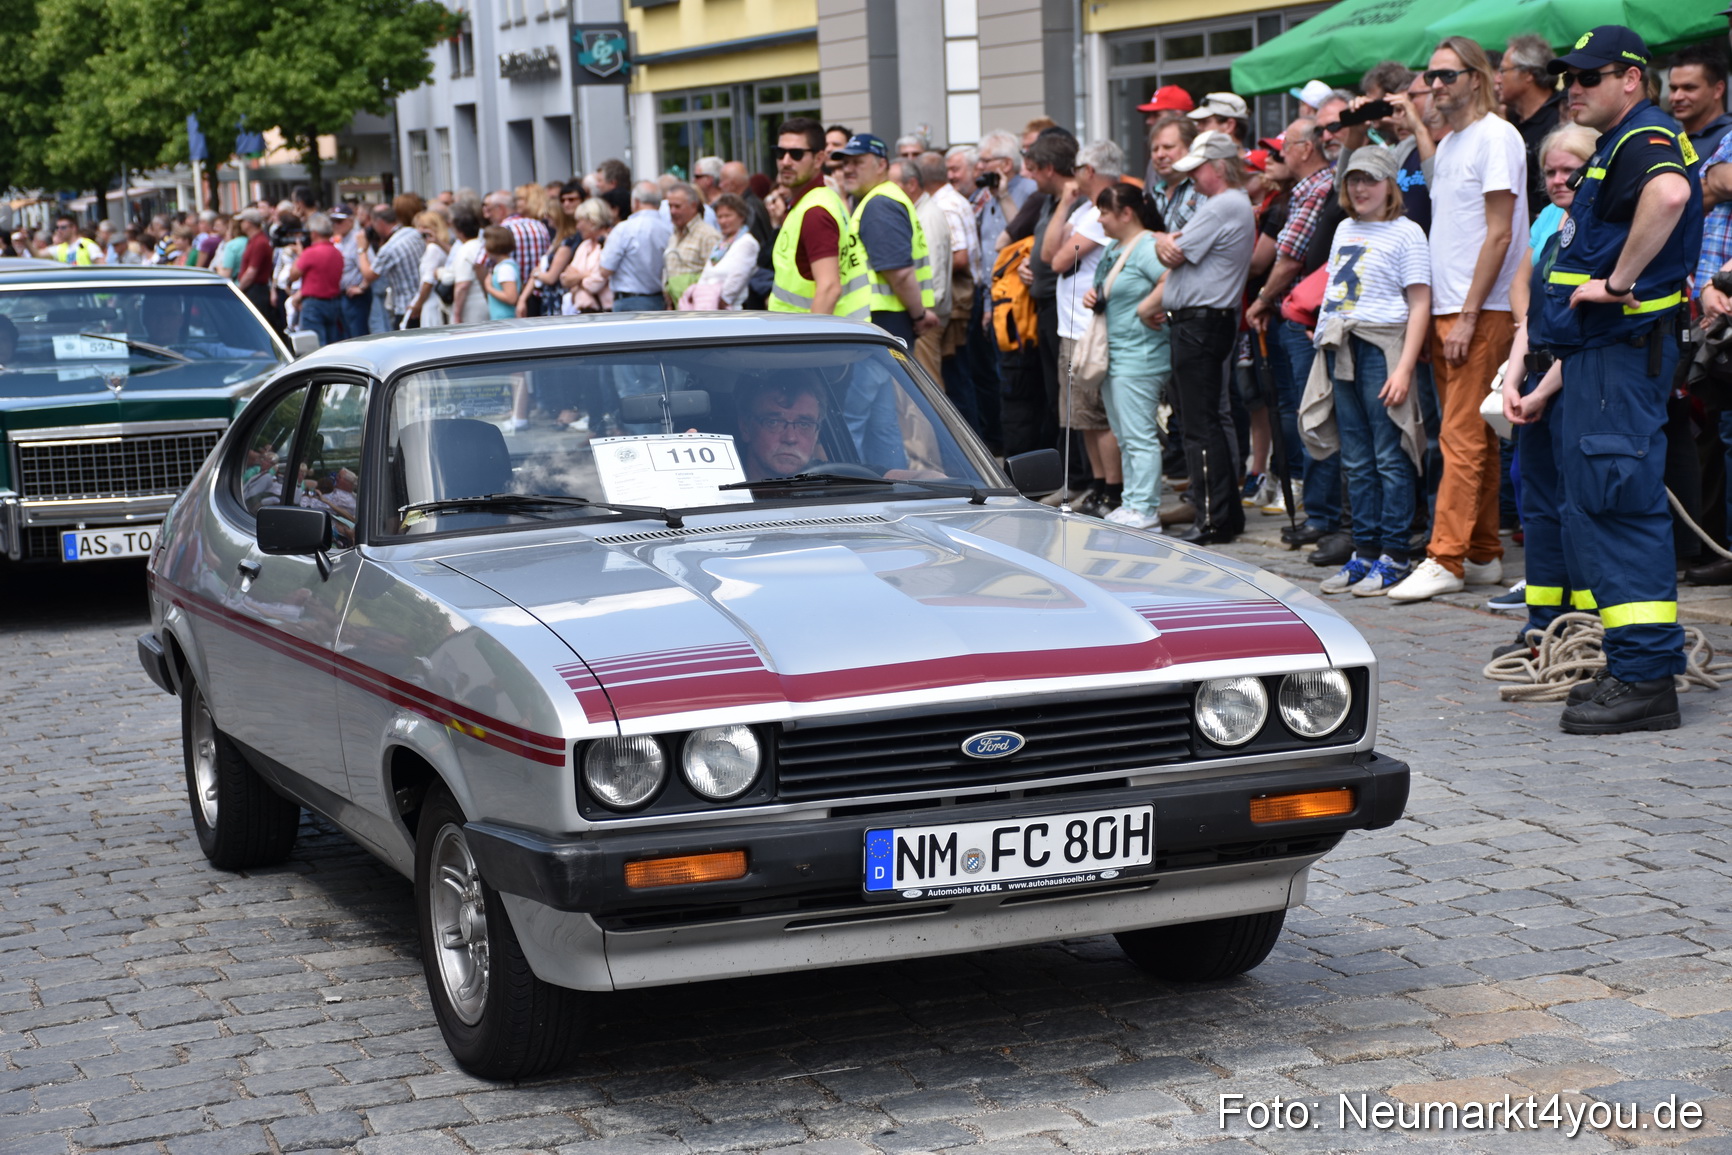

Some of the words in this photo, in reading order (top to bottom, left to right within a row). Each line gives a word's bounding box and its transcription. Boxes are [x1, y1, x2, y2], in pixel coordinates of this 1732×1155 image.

[1323, 245, 1367, 312] 3
[90, 342, 114, 353] 524
[667, 447, 716, 464] 110
[80, 535, 108, 556] AS
[123, 531, 152, 552] TO
[977, 736, 1010, 753] Ford
[896, 832, 957, 881] NM
[991, 823, 1051, 872] FC
[1064, 812, 1151, 864] 80H
[874, 866, 884, 880] D
[927, 886, 972, 897] Automobile
[973, 882, 1003, 893] KÖLBL
[1008, 873, 1096, 890] www.autohauskoelbl.de
